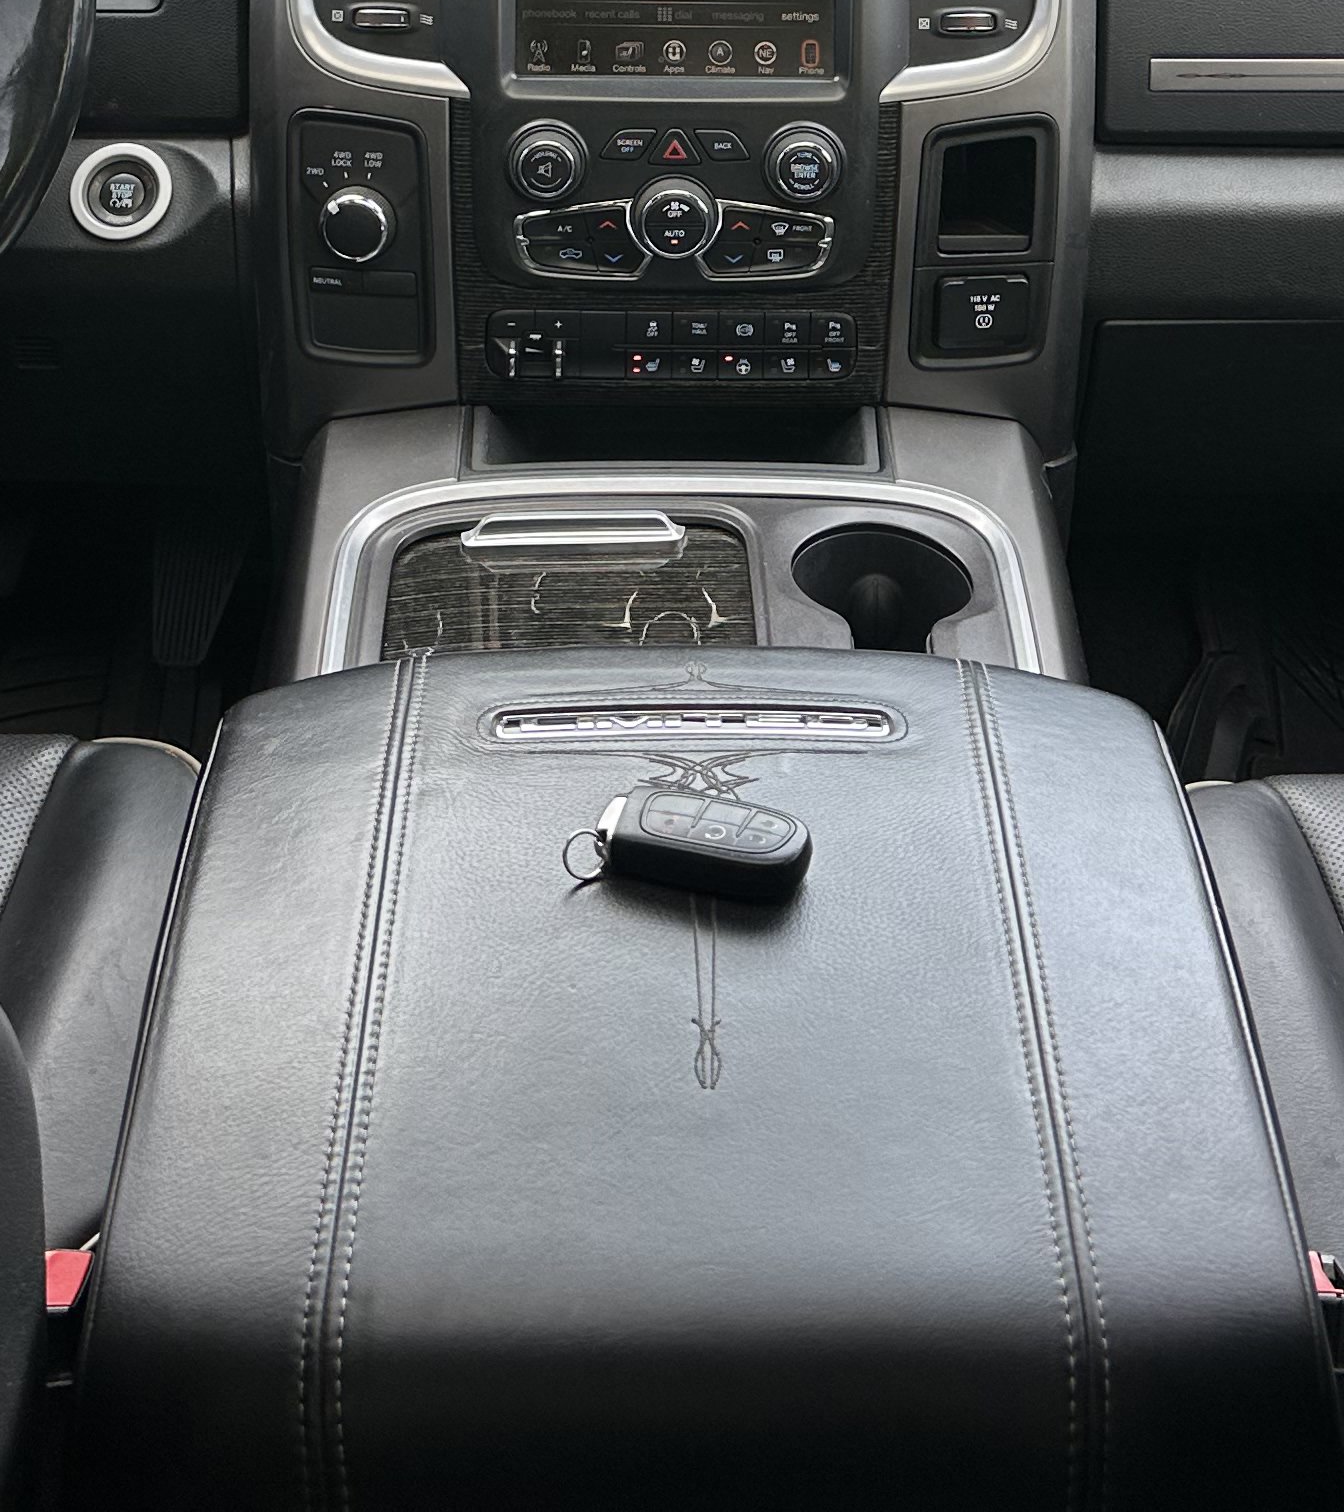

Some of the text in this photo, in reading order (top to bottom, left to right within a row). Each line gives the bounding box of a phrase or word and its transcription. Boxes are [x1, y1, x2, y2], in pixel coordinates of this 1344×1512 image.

[522, 9, 577, 20] phonebook
[584, 10, 640, 19] recent calls
[674, 10, 693, 20] dial
[711, 11, 765, 23] messaging
[781, 11, 820, 24] settings
[758, 48, 773, 58] NE
[570, 63, 596, 72] Media
[612, 64, 647, 73] Controls
[663, 65, 685, 75] Apps
[705, 66, 736, 74] Climate
[757, 66, 775, 74] Nav
[616, 138, 643, 147] SCREEN
[714, 142, 732, 150] BACK
[331, 158, 353, 168] LOCK
[363, 159, 383, 168] LOW
[306, 166, 325, 176] 2WD
[109, 183, 136, 191] START
[111, 190, 134, 199] STOP
[667, 210, 683, 219] OFF
[557, 224, 573, 233] A/C
[664, 229, 685, 238] AUTO
[312, 276, 343, 287] NEUTRAL
